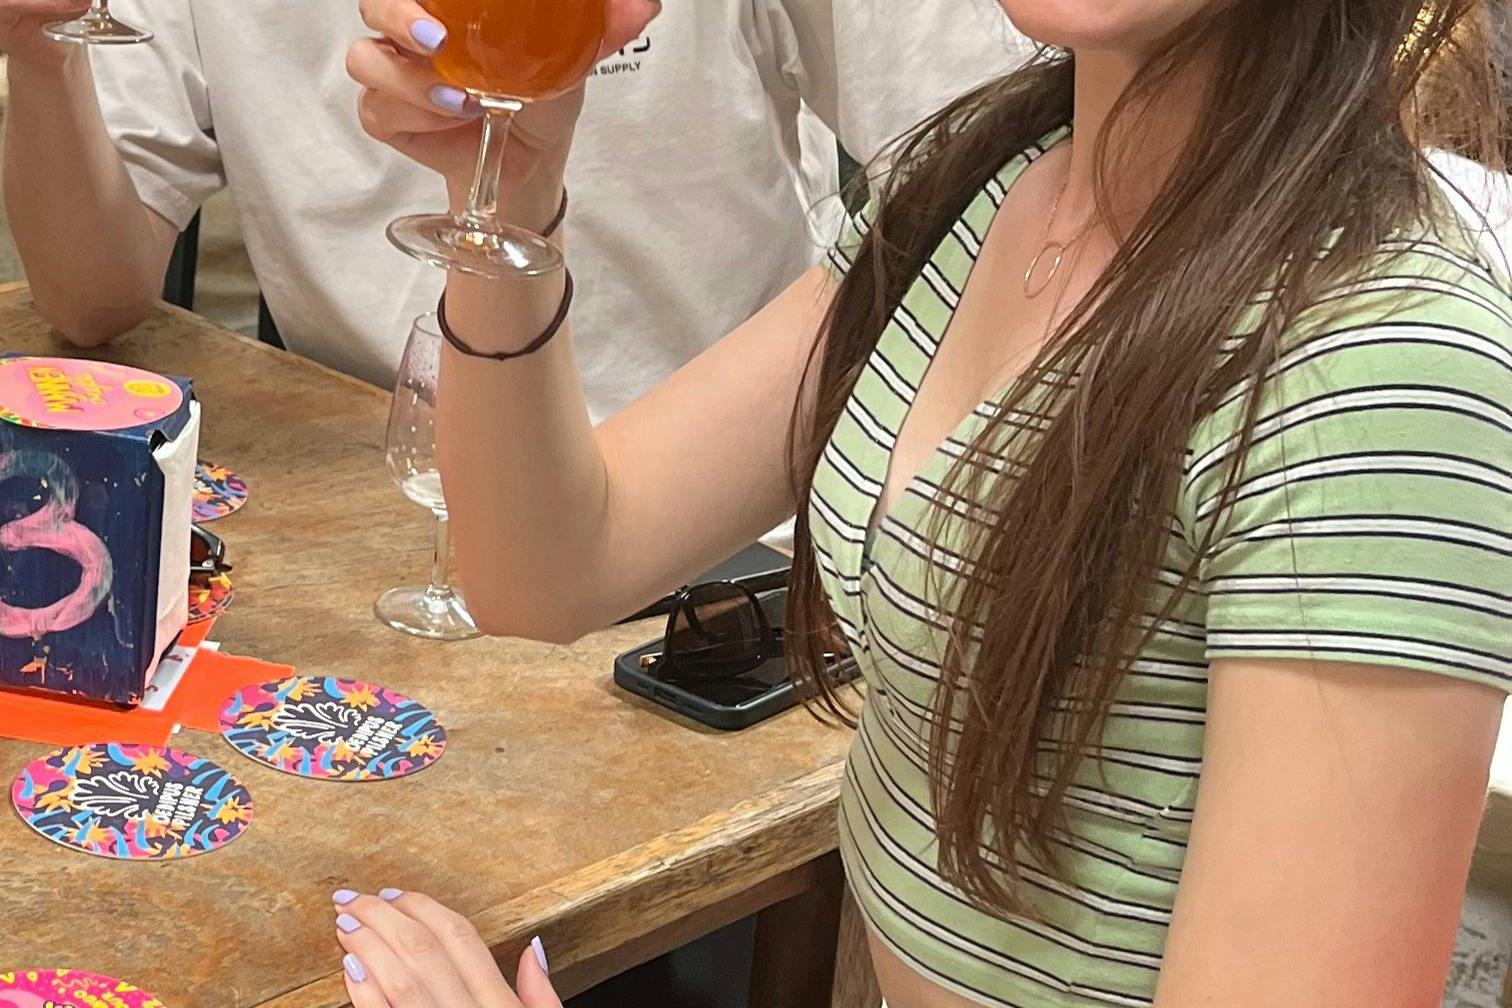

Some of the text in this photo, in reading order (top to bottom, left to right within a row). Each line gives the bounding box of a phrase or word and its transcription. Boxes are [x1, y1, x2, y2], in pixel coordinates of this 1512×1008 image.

[600, 61, 641, 75] SUPPLY
[347, 716, 385, 752] OEDIPUS
[359, 721, 403, 759] PILSNER
[152, 782, 184, 826] OEDIPUS
[169, 786, 204, 831] PILSNER
